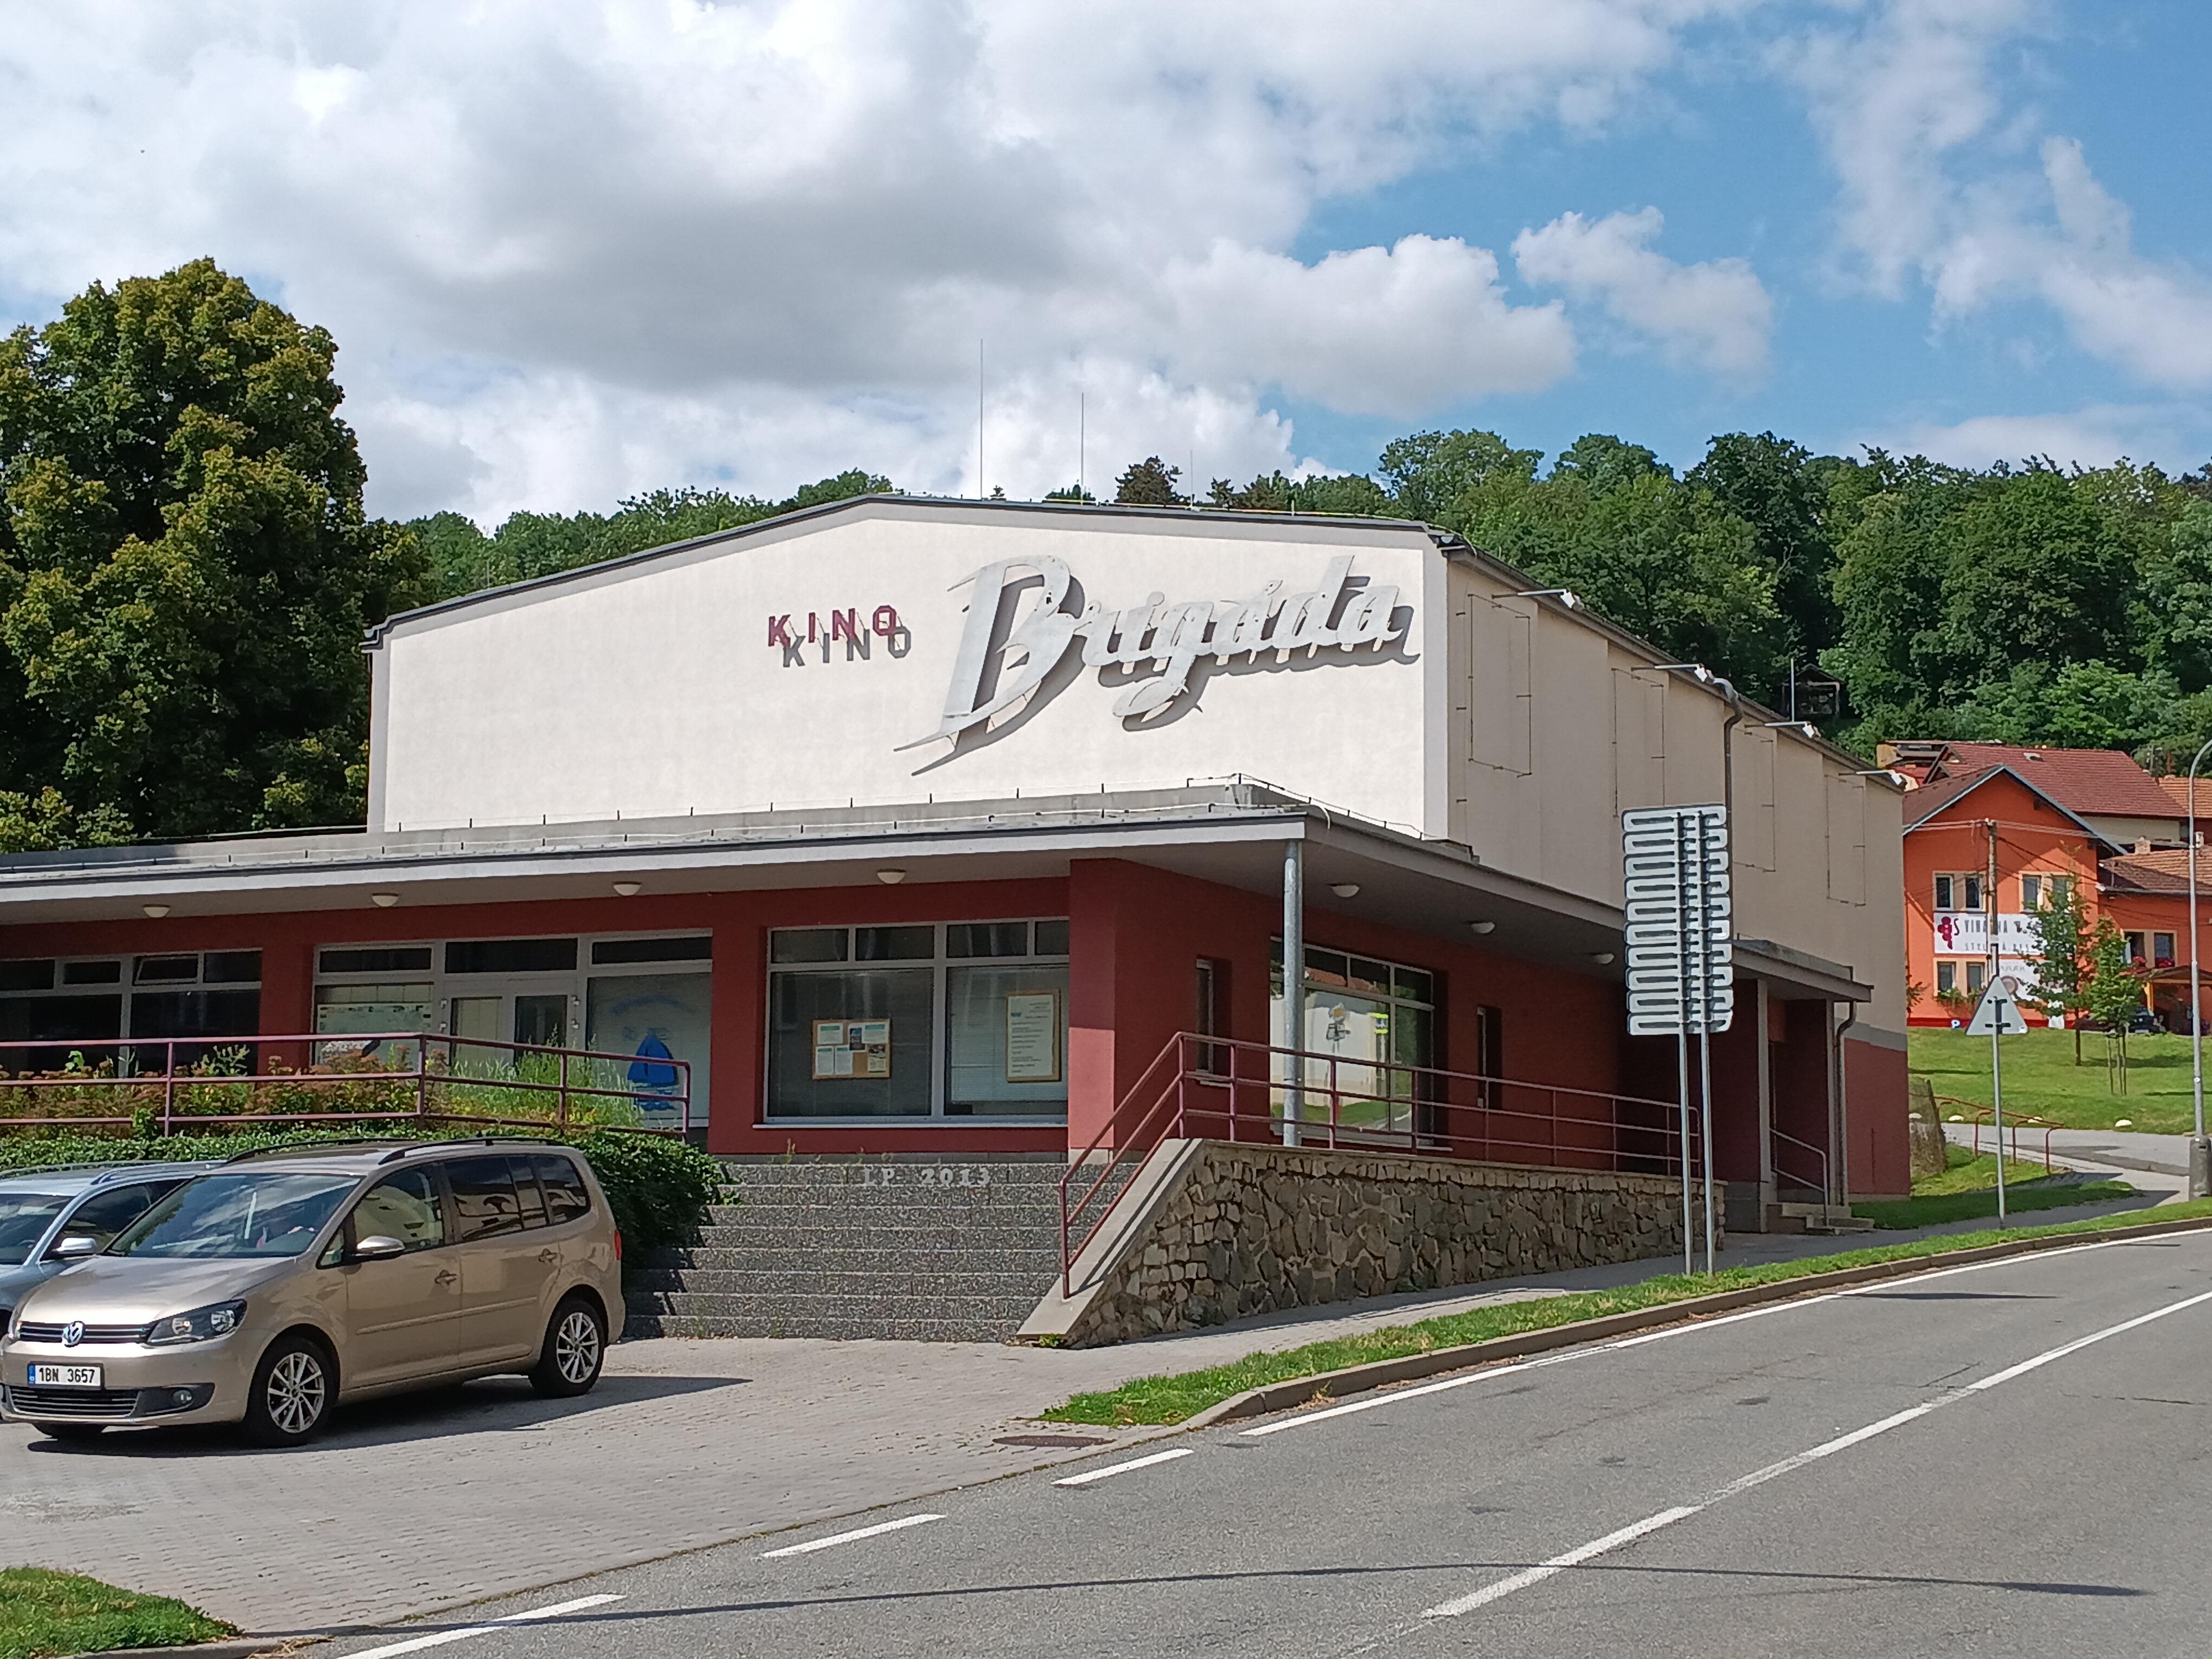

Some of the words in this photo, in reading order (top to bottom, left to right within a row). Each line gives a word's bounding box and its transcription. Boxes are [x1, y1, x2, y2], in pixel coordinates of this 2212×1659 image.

[768, 605, 897, 646] KINO
[894, 555, 1405, 752] Brigáda
[1951, 1019, 1960, 1029] P
[921, 1168, 990, 1186] 2013
[39, 1368, 59, 1382] 1BN
[67, 1368, 95, 1383] 3657
